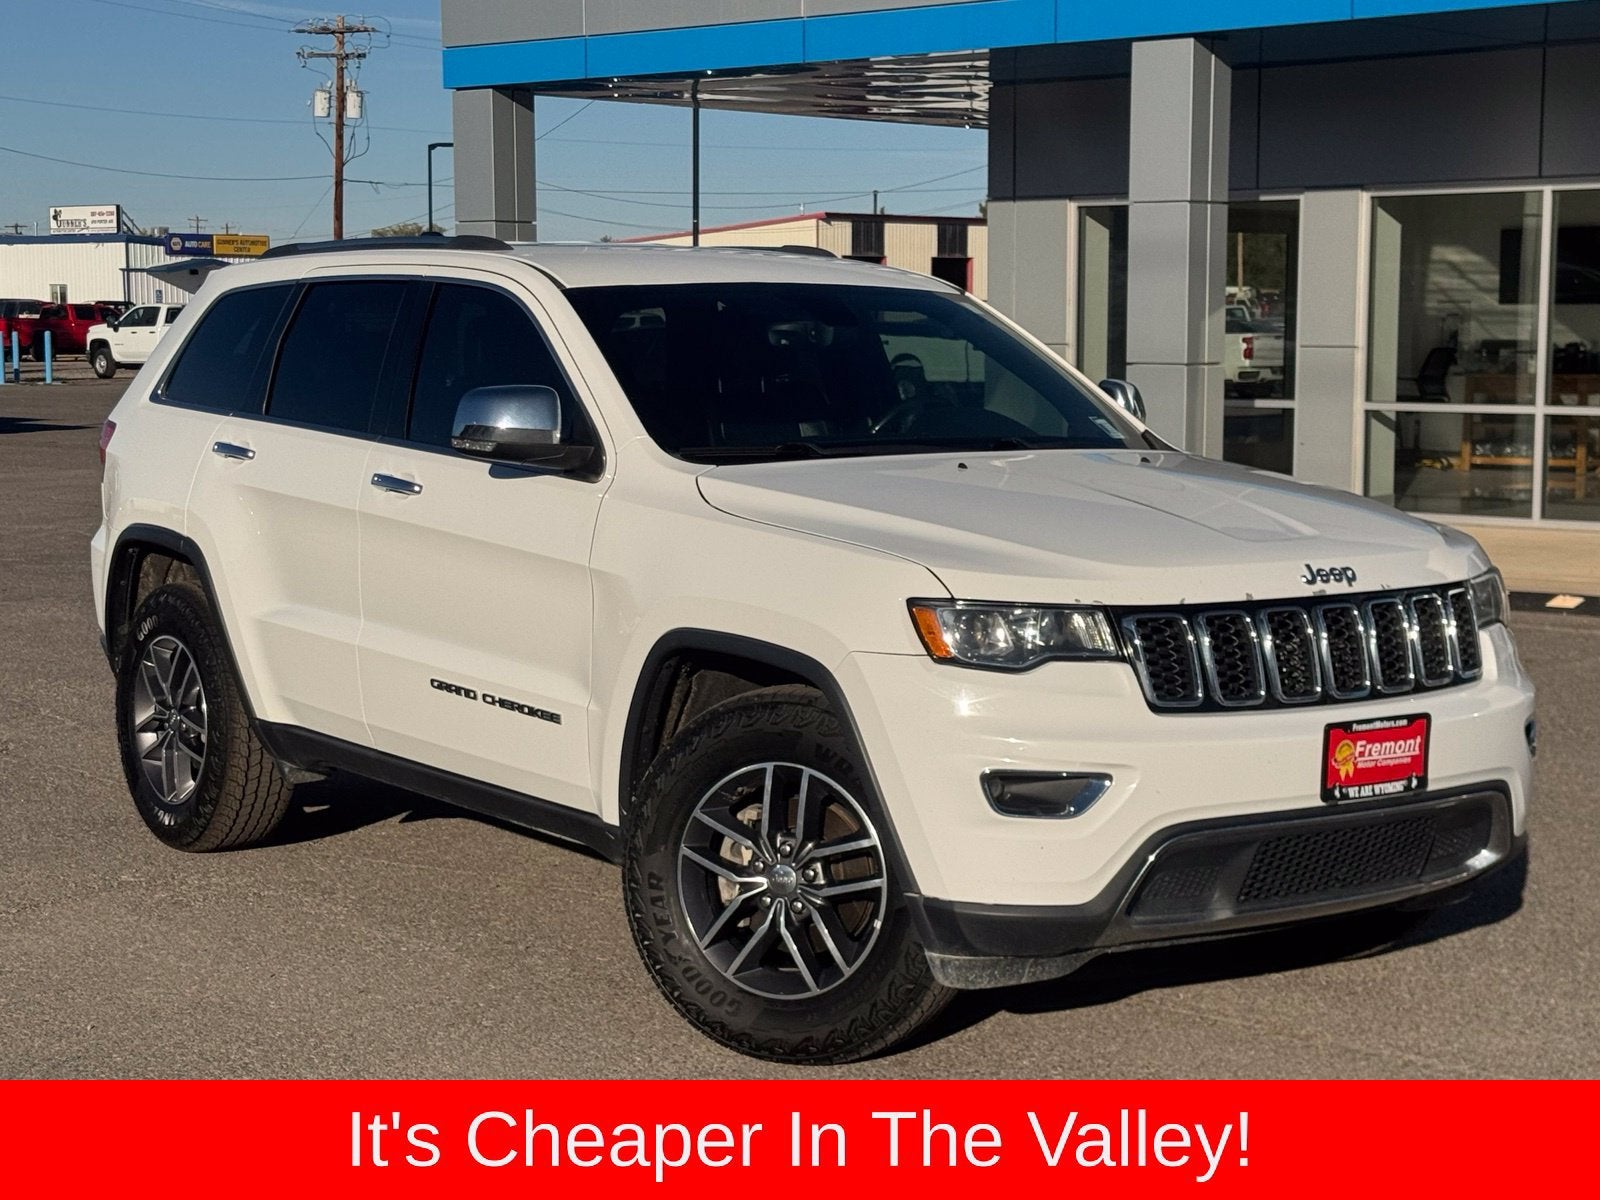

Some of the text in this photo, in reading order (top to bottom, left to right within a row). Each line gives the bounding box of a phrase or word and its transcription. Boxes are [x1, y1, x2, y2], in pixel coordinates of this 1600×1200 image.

[185, 240, 198, 248] AUTO
[1301, 563, 1357, 587] Jeep
[430, 678, 562, 725] GRAND CHEROKEE
[1355, 735, 1421, 758] Fremont
[1356, 756, 1411, 769] Motor Companies
